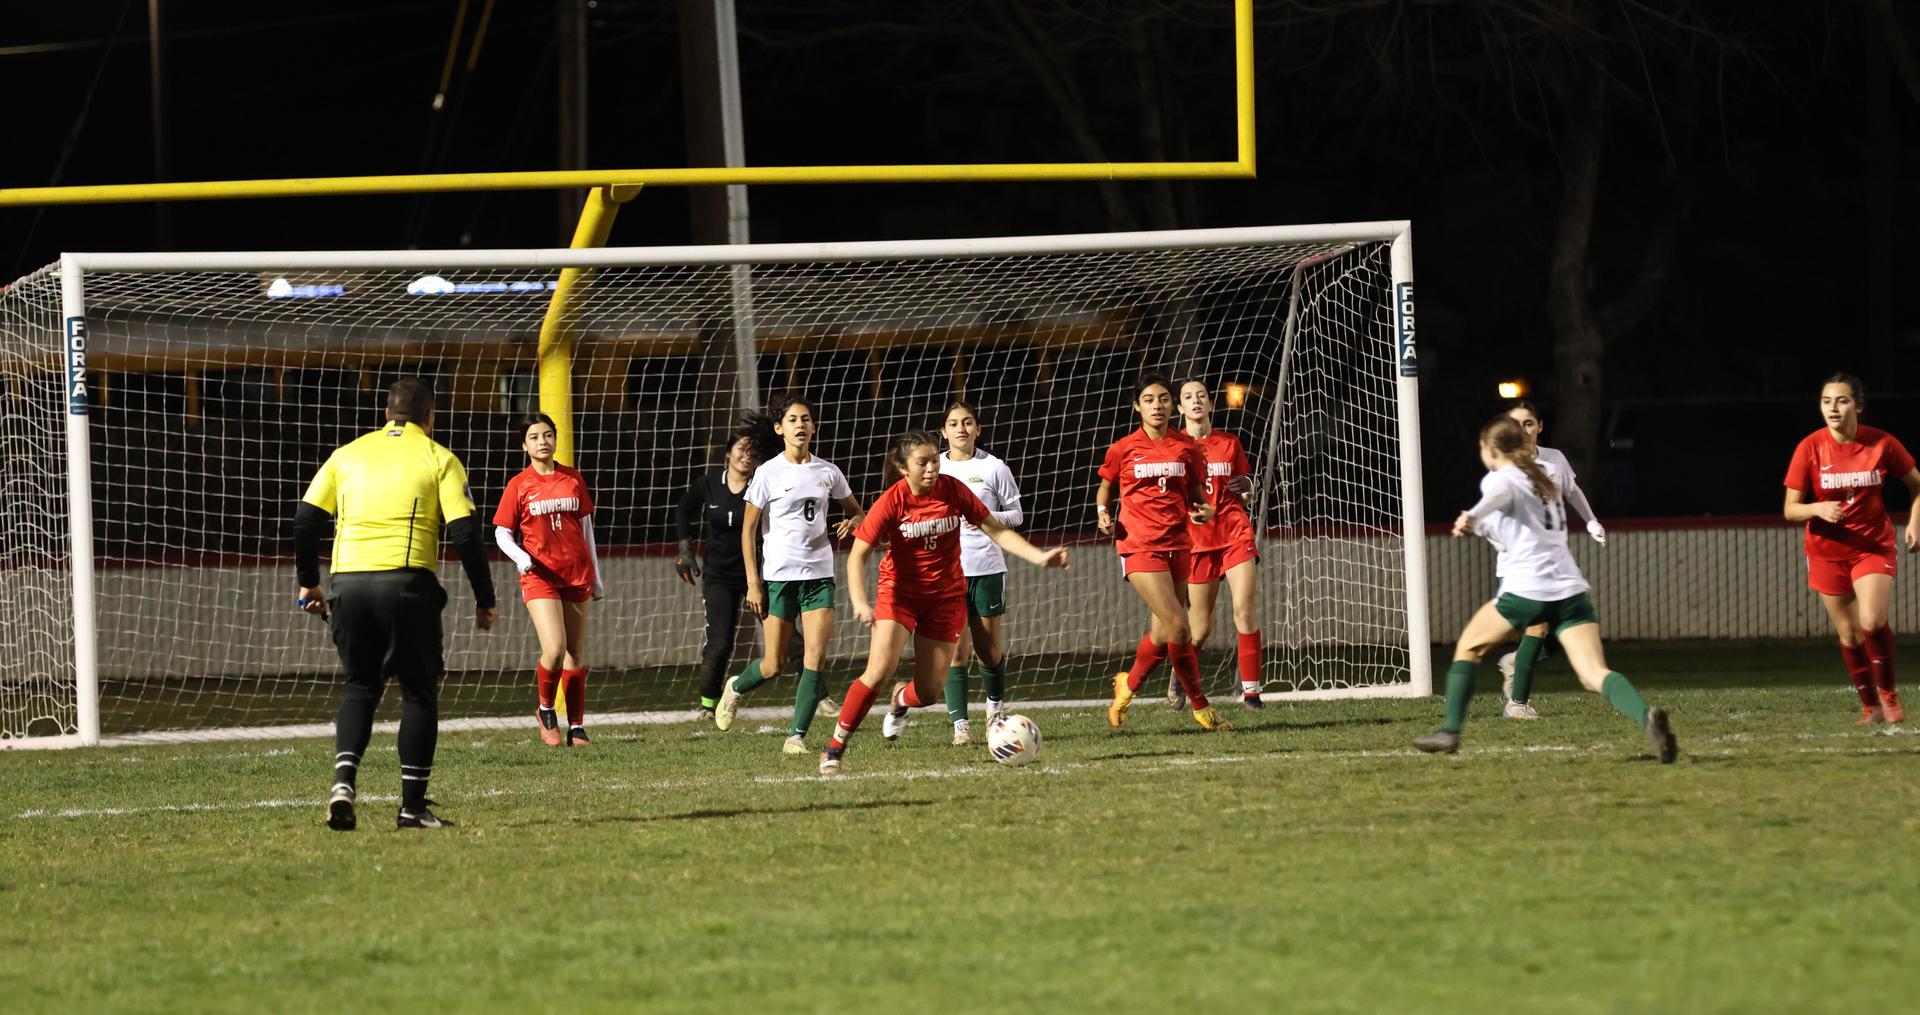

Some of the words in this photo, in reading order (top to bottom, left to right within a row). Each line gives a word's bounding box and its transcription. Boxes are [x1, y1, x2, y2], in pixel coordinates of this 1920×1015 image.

[1402, 286, 1417, 360] FORZA
[71, 320, 88, 397] FORZA
[1158, 476, 1166, 494] 9
[1205, 478, 1214, 494] 5
[728, 511, 733, 527] 1
[804, 498, 816, 522] 6
[550, 513, 562, 531] 14
[923, 535, 938, 551] 15
